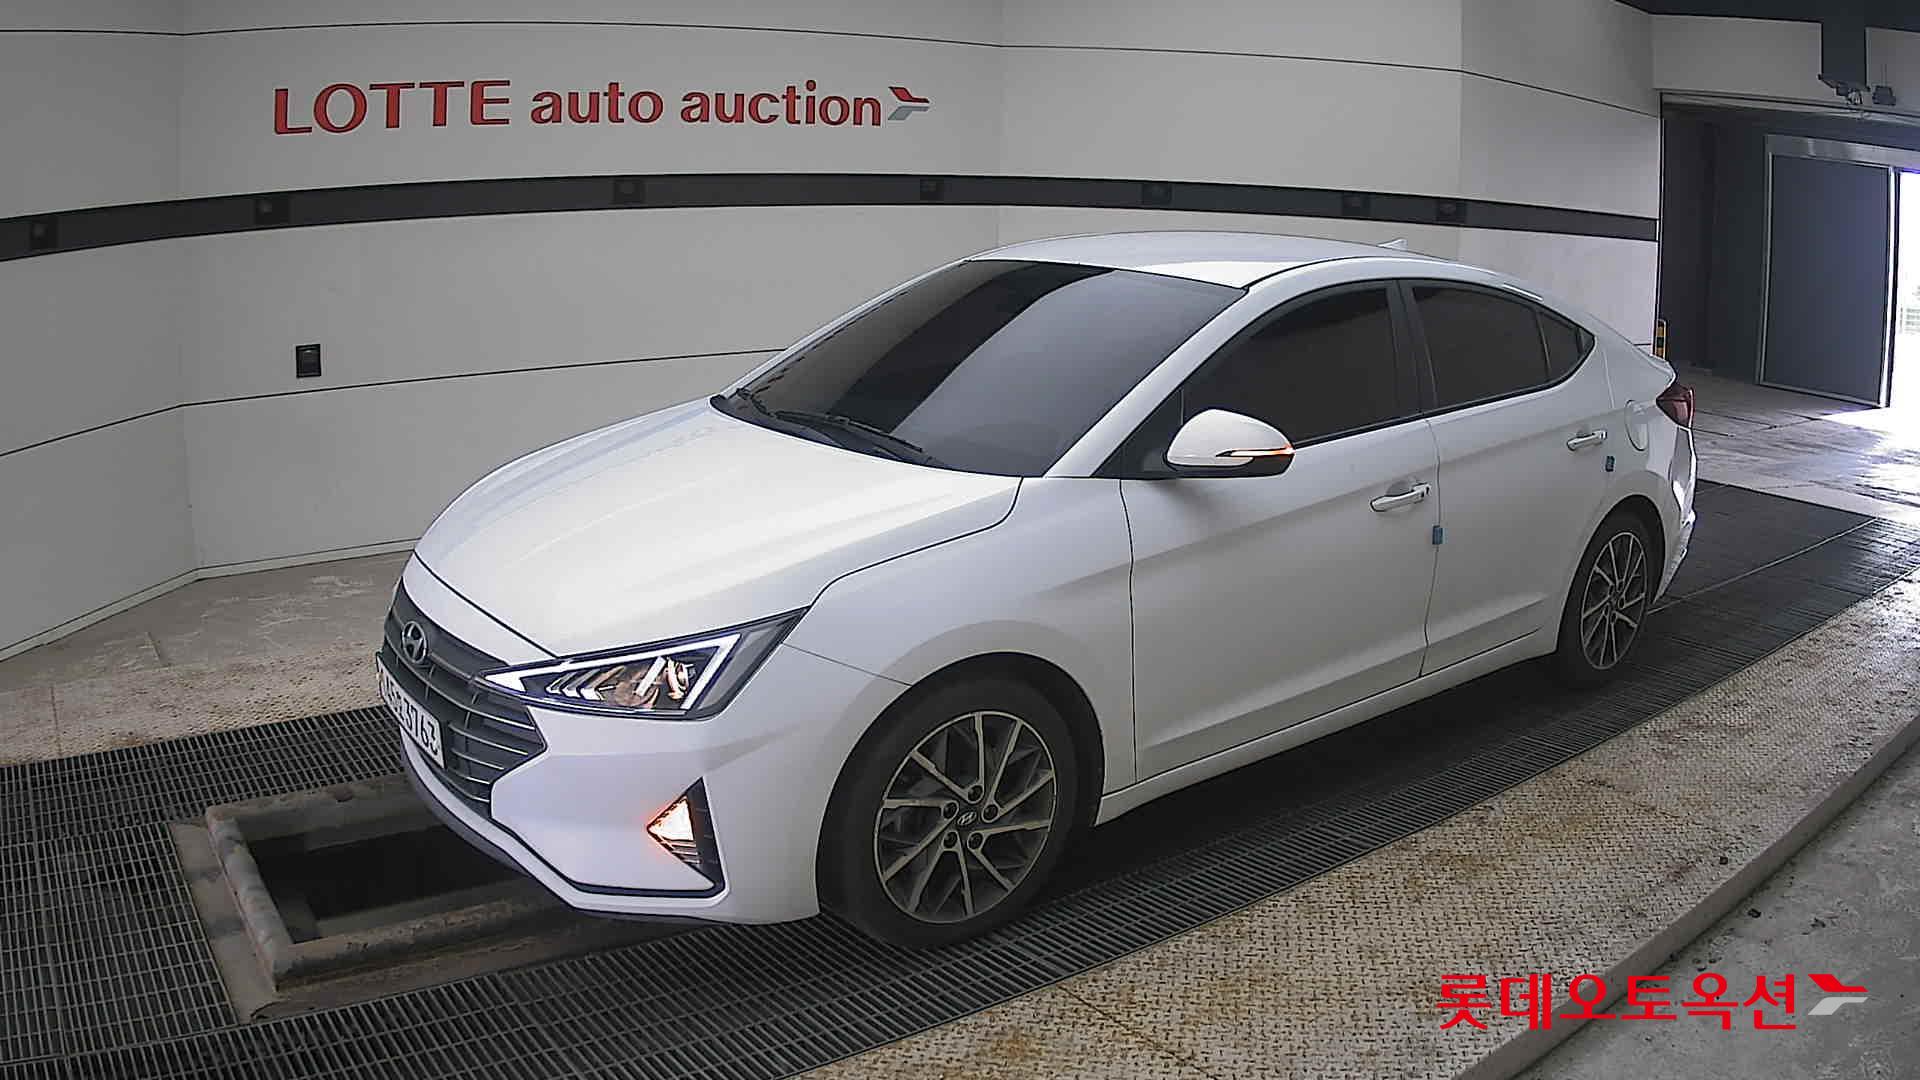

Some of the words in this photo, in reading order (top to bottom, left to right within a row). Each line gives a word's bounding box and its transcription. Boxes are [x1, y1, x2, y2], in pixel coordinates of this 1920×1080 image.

[274, 80, 510, 135] LOTTE
[530, 81, 664, 125] auto
[680, 80, 882, 126] auction
